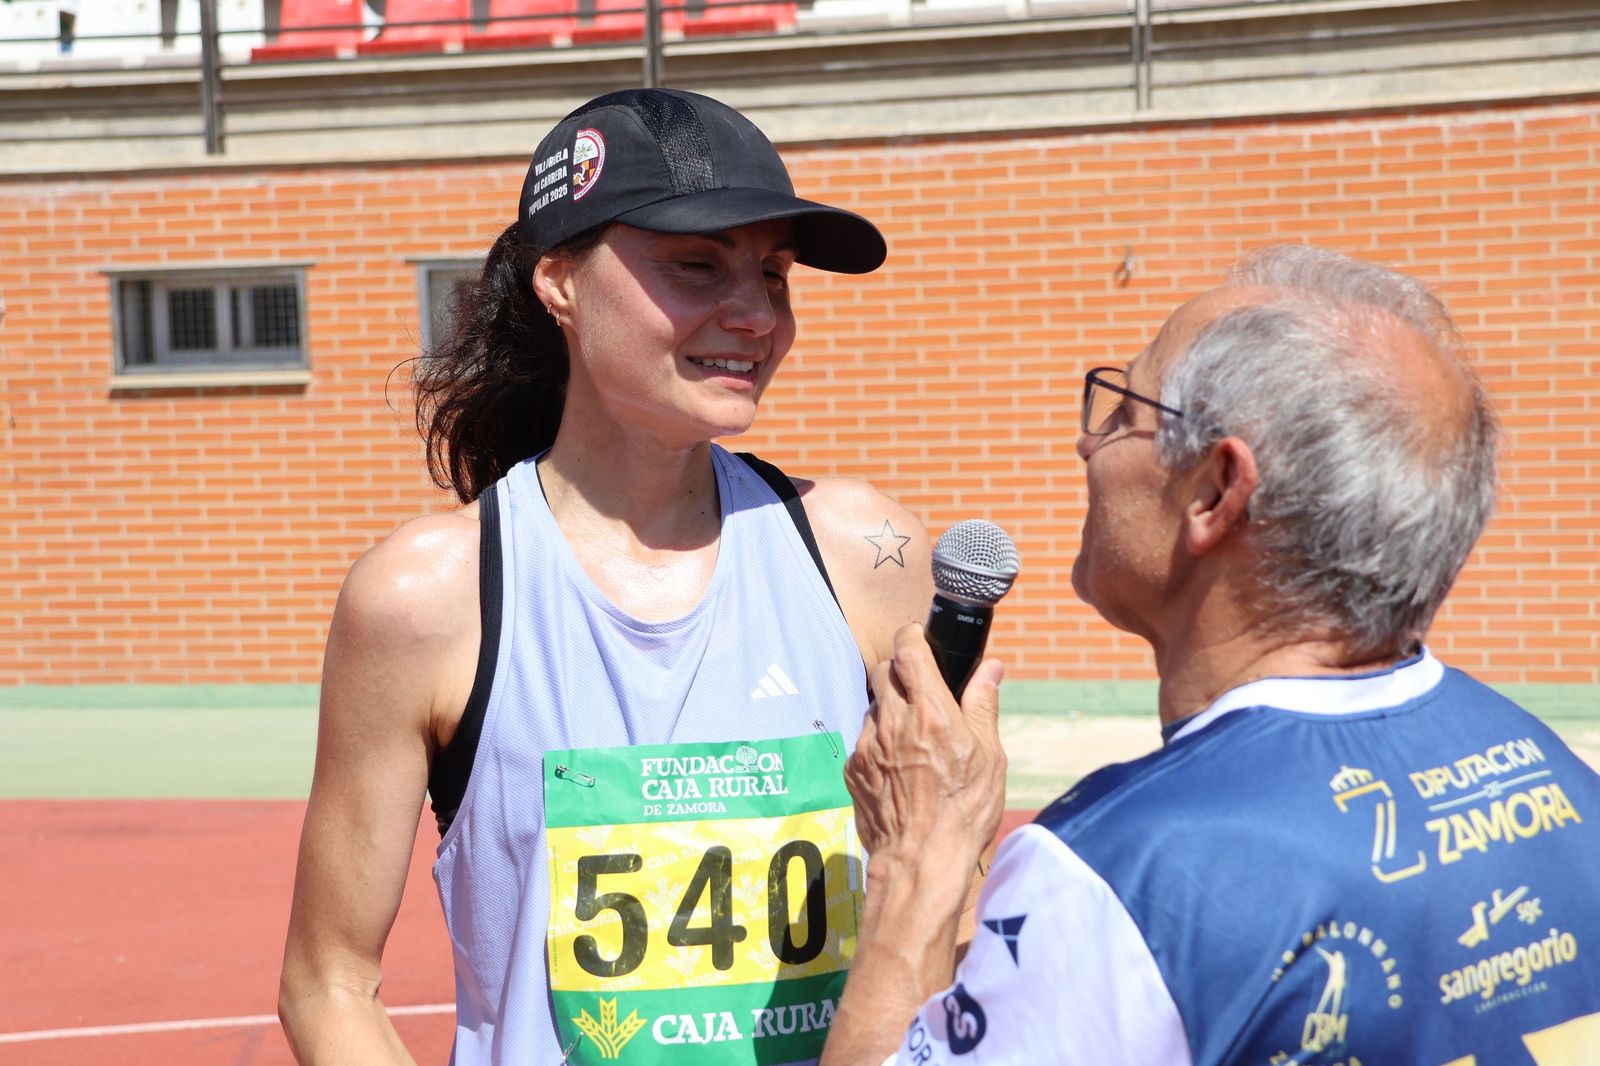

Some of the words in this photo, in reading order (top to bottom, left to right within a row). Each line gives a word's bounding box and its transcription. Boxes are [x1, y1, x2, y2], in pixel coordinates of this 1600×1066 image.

[550, 183, 568, 203] 2025
[641, 778, 703, 801] CAJA
[709, 774, 789, 798] RURAL
[643, 804, 663, 817] DE
[667, 801, 727, 815] ZAMORA
[1424, 783, 1583, 865] ZAMORA
[573, 840, 827, 978] 540
[1439, 927, 1578, 1005] sangregorio
[652, 1011, 743, 1045] CAJA
